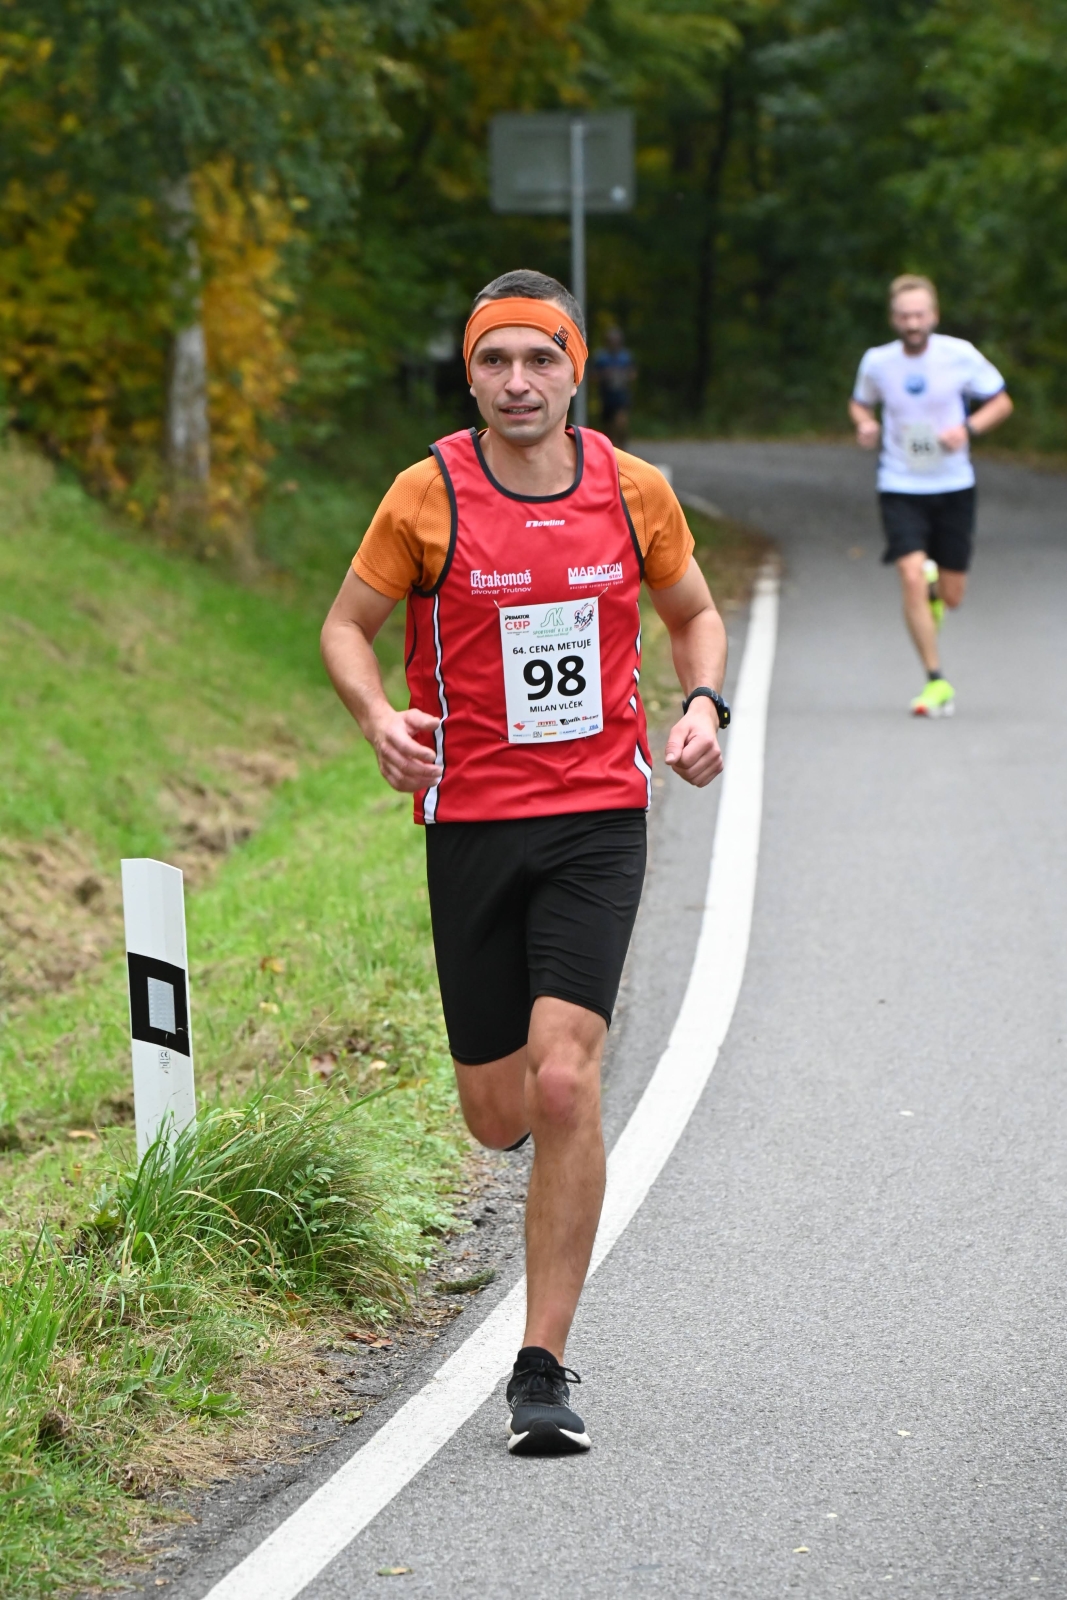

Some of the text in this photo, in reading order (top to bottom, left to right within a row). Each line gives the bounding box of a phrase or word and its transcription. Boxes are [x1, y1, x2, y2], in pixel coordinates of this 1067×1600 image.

[567, 562, 622, 577] MARATON
[470, 569, 532, 588] Krakonoš
[502, 586, 532, 594] Trutnov
[505, 620, 530, 631] CUP
[513, 639, 591, 655] 64. CENA METUJE
[523, 655, 587, 701] 98
[530, 700, 583, 713] MILAN VLČEK
